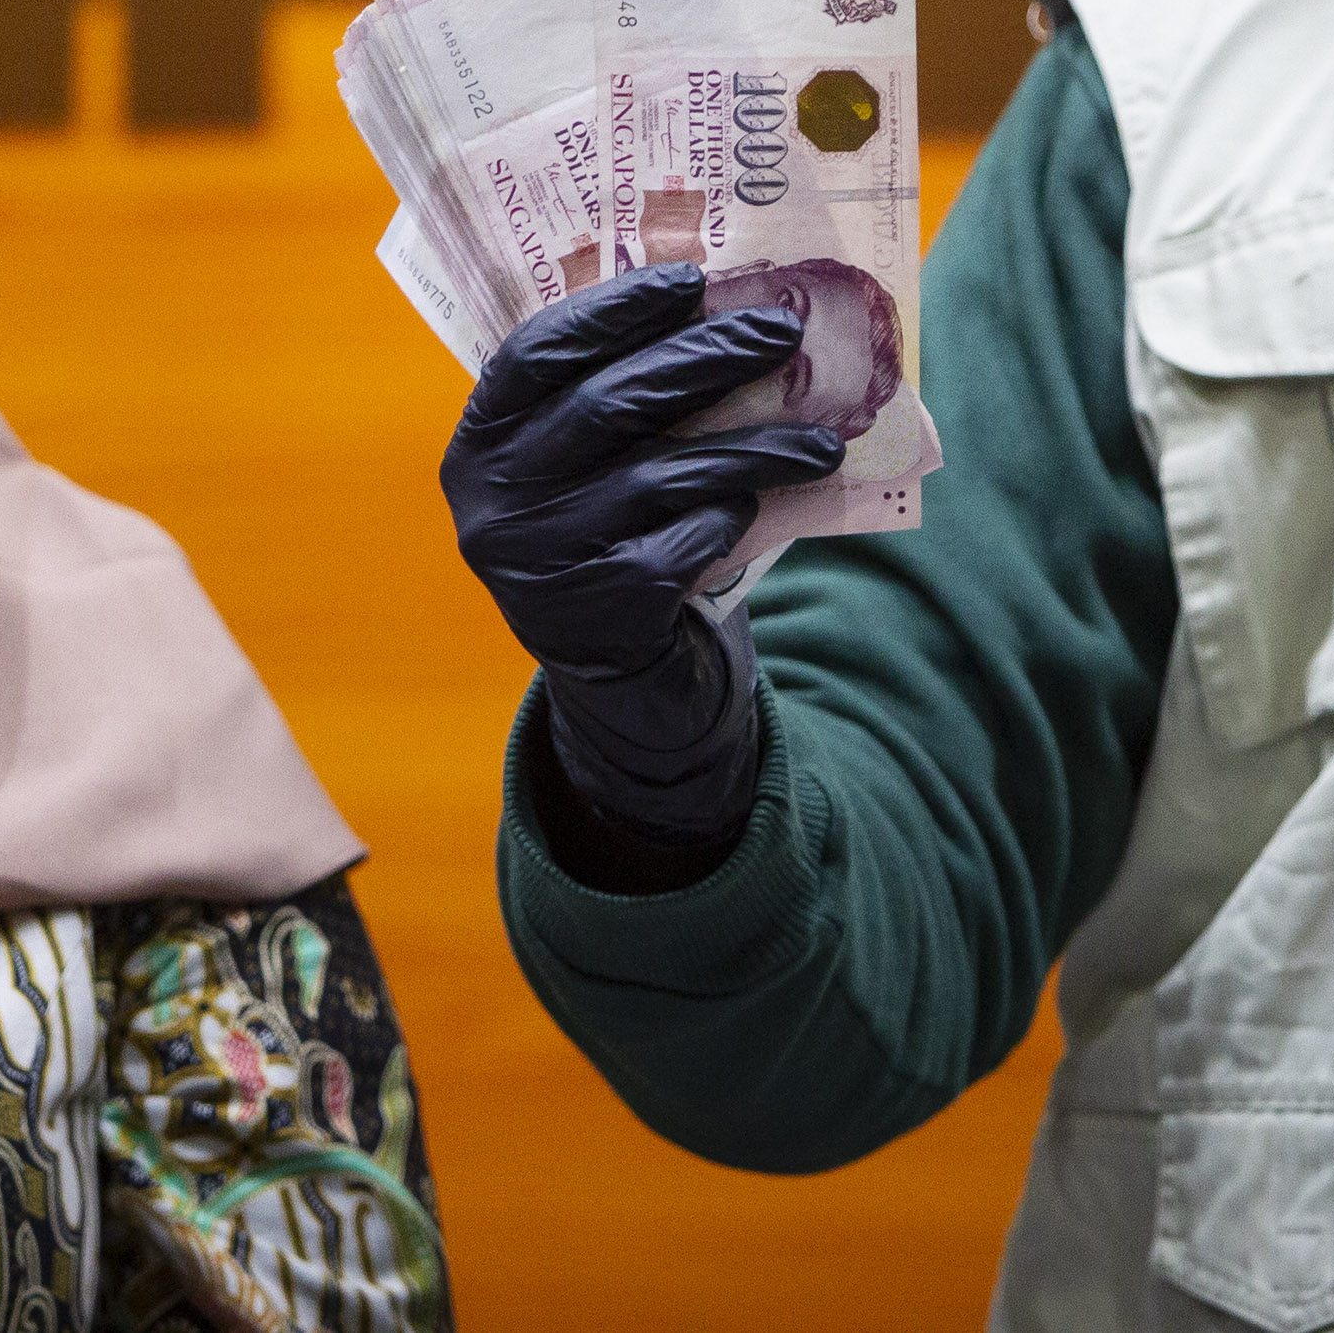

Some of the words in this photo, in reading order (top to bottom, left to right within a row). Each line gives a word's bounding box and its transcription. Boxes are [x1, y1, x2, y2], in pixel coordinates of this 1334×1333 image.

[439, 21, 494, 118] 5AB335122
[706, 70, 723, 117] ONE
[555, 127, 601, 229] DOLLARS
[571, 121, 598, 166] ONE
[613, 74, 637, 242] SINGAPORE
[688, 71, 705, 178] DOLLARS
[733, 71, 789, 206] 1000
[487, 158, 560, 302] SINGAPOR
[707, 126, 725, 248] THOUSAND
